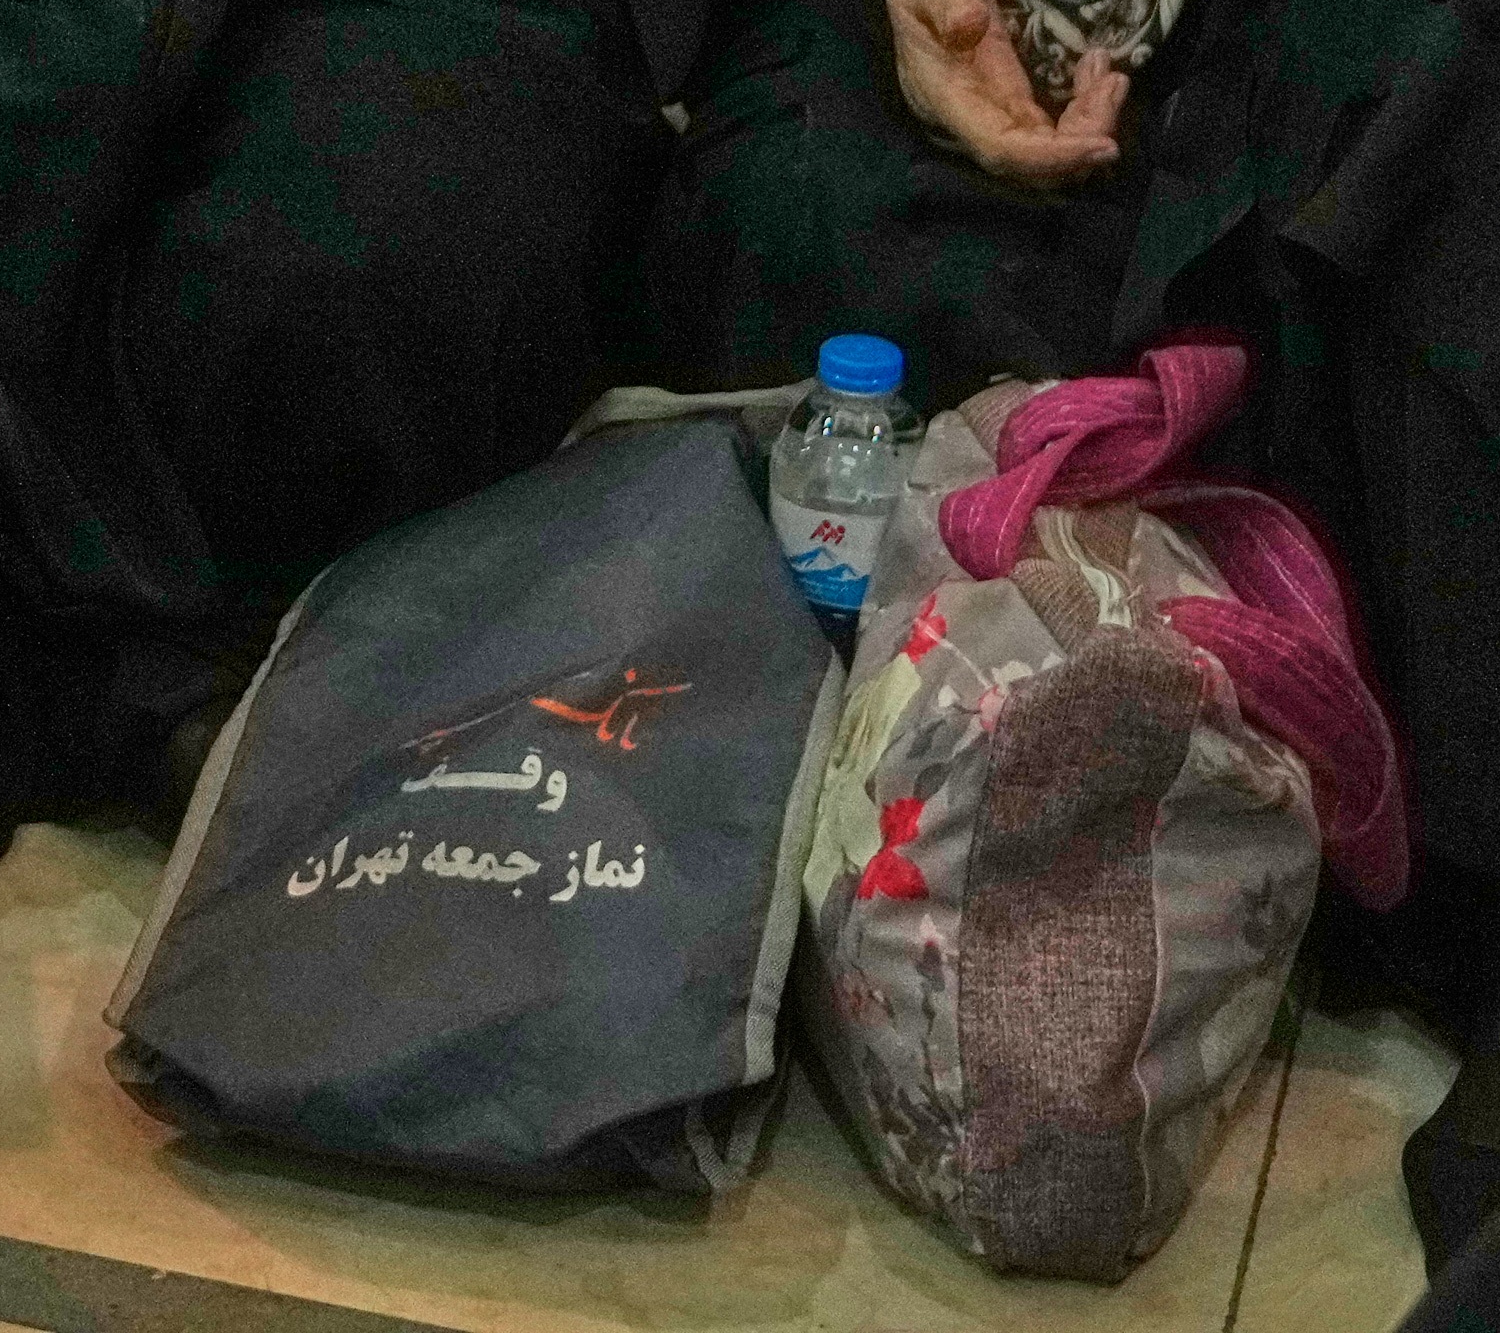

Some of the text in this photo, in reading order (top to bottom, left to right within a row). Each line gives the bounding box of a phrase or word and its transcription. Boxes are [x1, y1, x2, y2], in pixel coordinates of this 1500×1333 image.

[286, 830, 646, 903] نماز جمعه تهران
